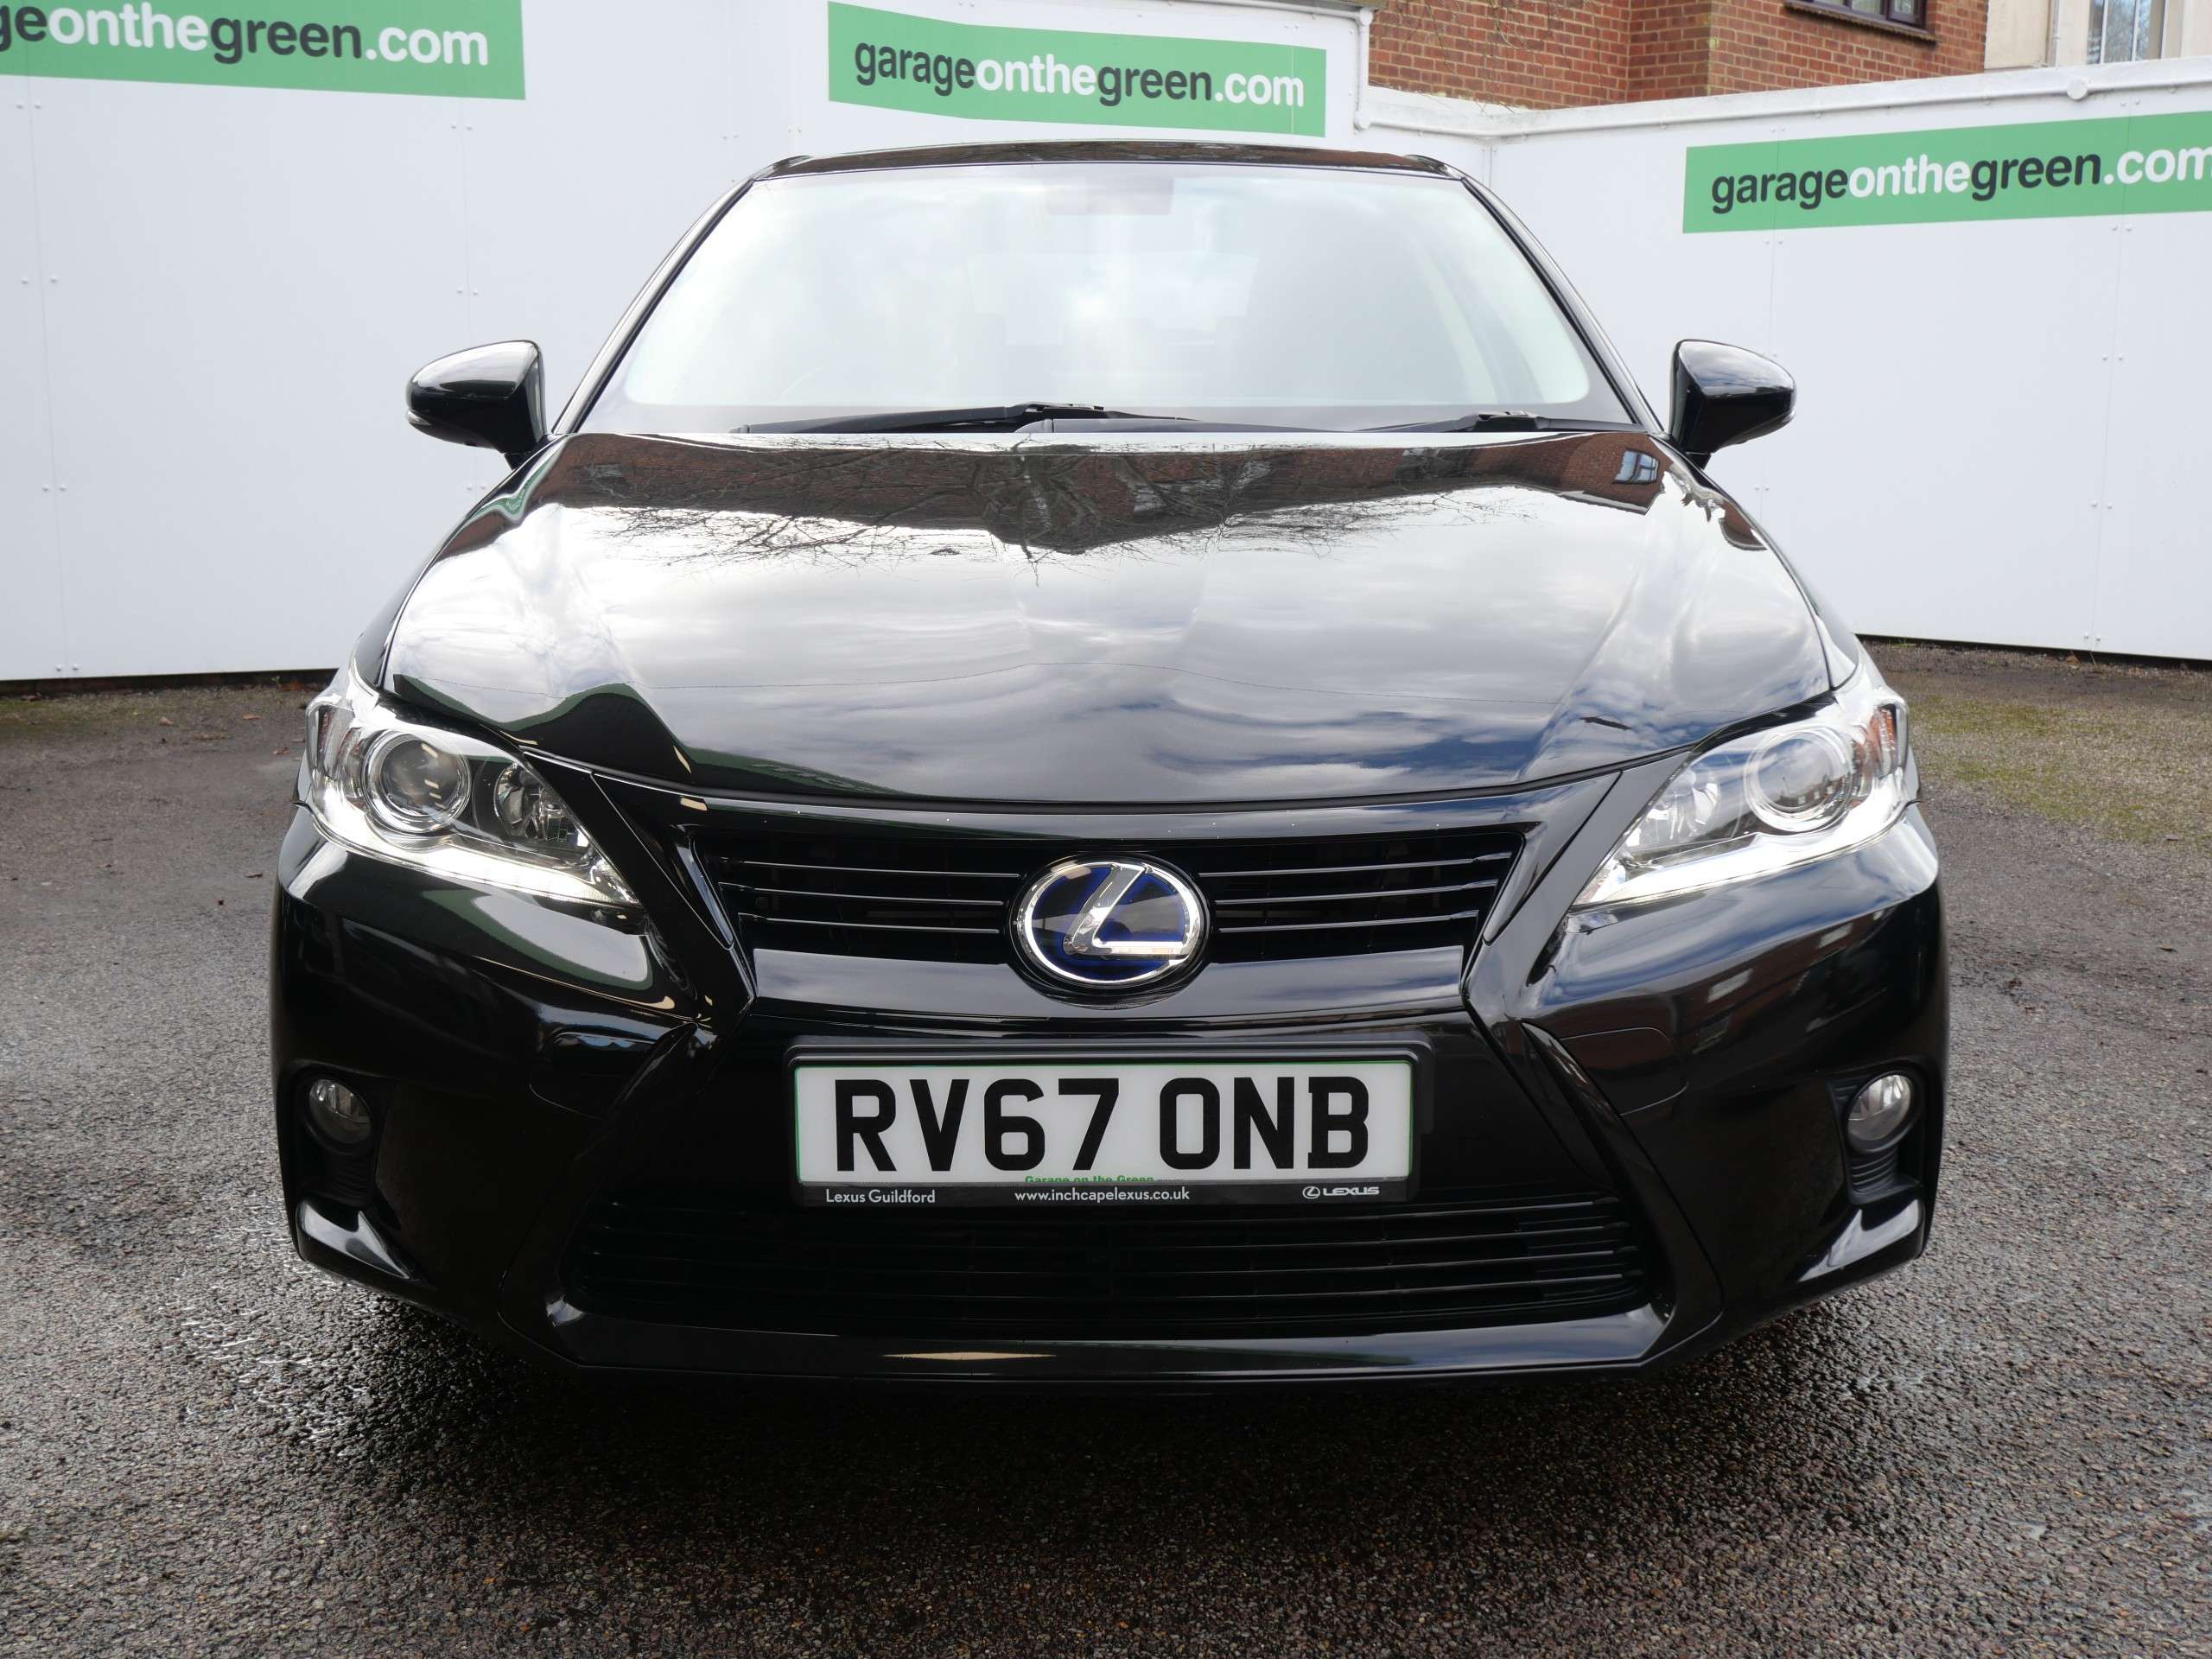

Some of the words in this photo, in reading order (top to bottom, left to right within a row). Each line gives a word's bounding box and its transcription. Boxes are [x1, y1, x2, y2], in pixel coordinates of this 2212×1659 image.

[855, 42, 1304, 106] garageonthegreen.com
[1711, 146, 2212, 214] garageonthegreen.com
[835, 1078, 1120, 1172] RV67
[1159, 1077, 1370, 1170] ONB
[826, 1189, 866, 1203] Lexus
[868, 1189, 936, 1203] Guildford
[1014, 1186, 1190, 1203] www.inchcapelexus.co.uk
[1323, 1186, 1380, 1196] LEXUS
